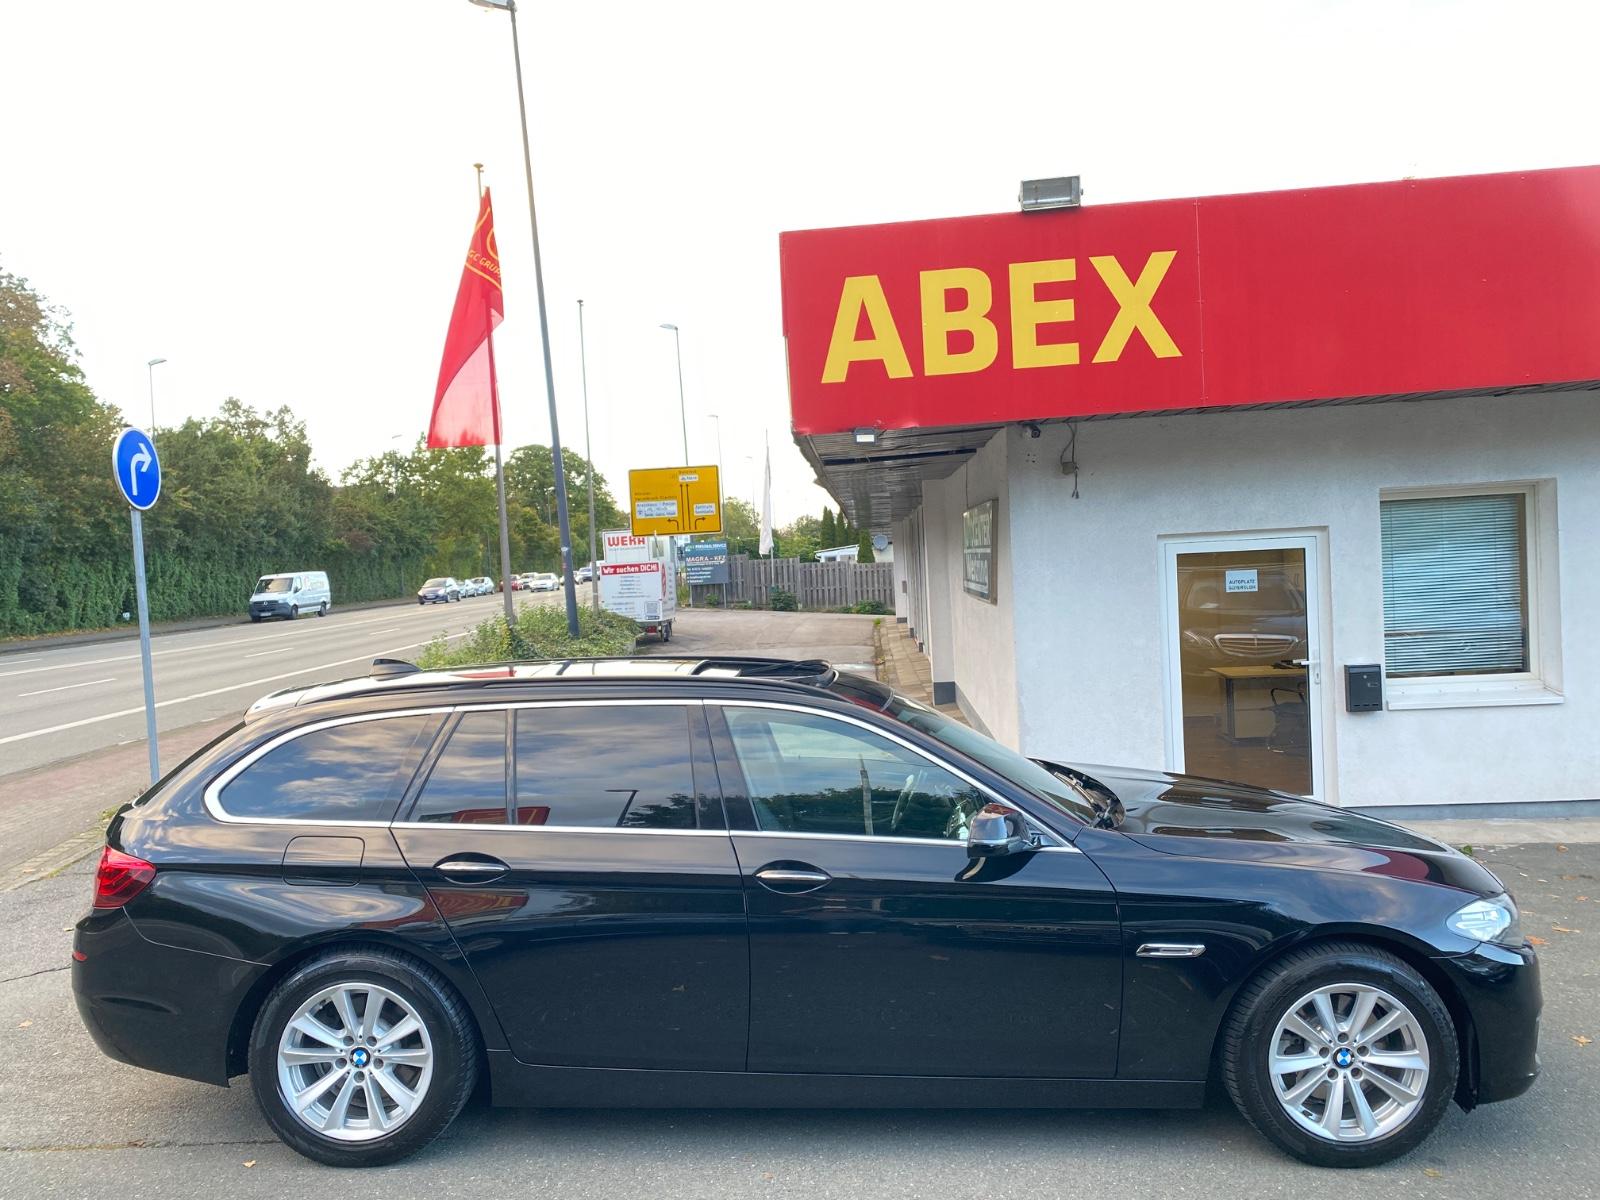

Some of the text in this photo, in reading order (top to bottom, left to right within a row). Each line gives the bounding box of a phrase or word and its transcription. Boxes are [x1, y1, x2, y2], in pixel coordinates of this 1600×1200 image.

[821, 251, 1182, 383] ABEX
[603, 563, 657, 574] Wir suchen DICH!
